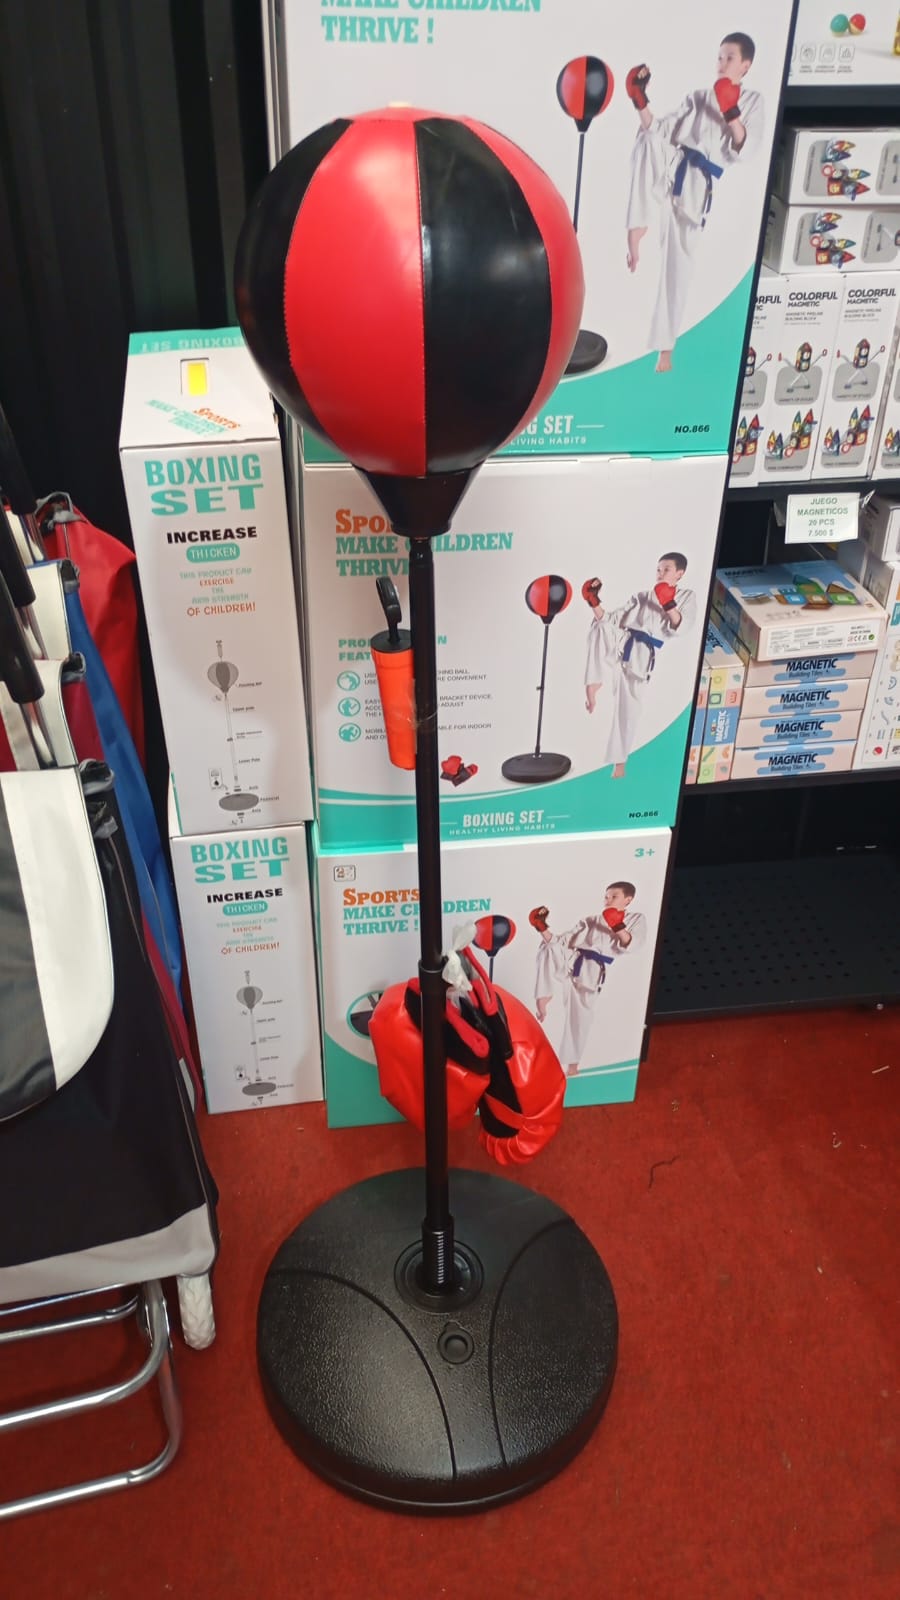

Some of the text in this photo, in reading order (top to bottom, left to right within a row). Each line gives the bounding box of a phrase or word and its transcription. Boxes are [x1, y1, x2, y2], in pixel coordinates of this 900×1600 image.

[321, 16, 418, 43] THRIVE
[788, 291, 838, 301] COLORFUL
[848, 288, 897, 298] COLORFUL
[543, 415, 574, 435] SET
[674, 425, 710, 434] NO.866
[144, 453, 262, 487] BOXING
[150, 483, 264, 516] SET
[810, 497, 838, 505] JUEGO
[797, 507, 848, 516] MAGNETICOS
[336, 509, 392, 534] SPO
[166, 526, 258, 544] INCREASE
[336, 535, 398, 555] MAKE
[191, 547, 237, 559] THICKEN
[187, 602, 256, 616] OF CHILDREN!
[786, 658, 838, 672] MAGNETIC
[780, 690, 831, 703] MAGNETIC
[775, 720, 825, 733] MAGNETIC
[768, 753, 818, 765] MAGNETIC
[463, 810, 545, 828] BOXING SET
[629, 811, 659, 819] NO.866
[450, 828, 489, 836] HEALTHY
[492, 825, 521, 833] LIVING
[191, 836, 288, 863] BOXING
[635, 848, 655, 857] 3+
[195, 858, 290, 884] SET
[207, 888, 283, 904] INCREASE
[343, 888, 420, 906] SPORTS
[226, 903, 265, 913] THICKEN
[343, 905, 395, 920] MAKE
[344, 920, 409, 935] THRIVE
